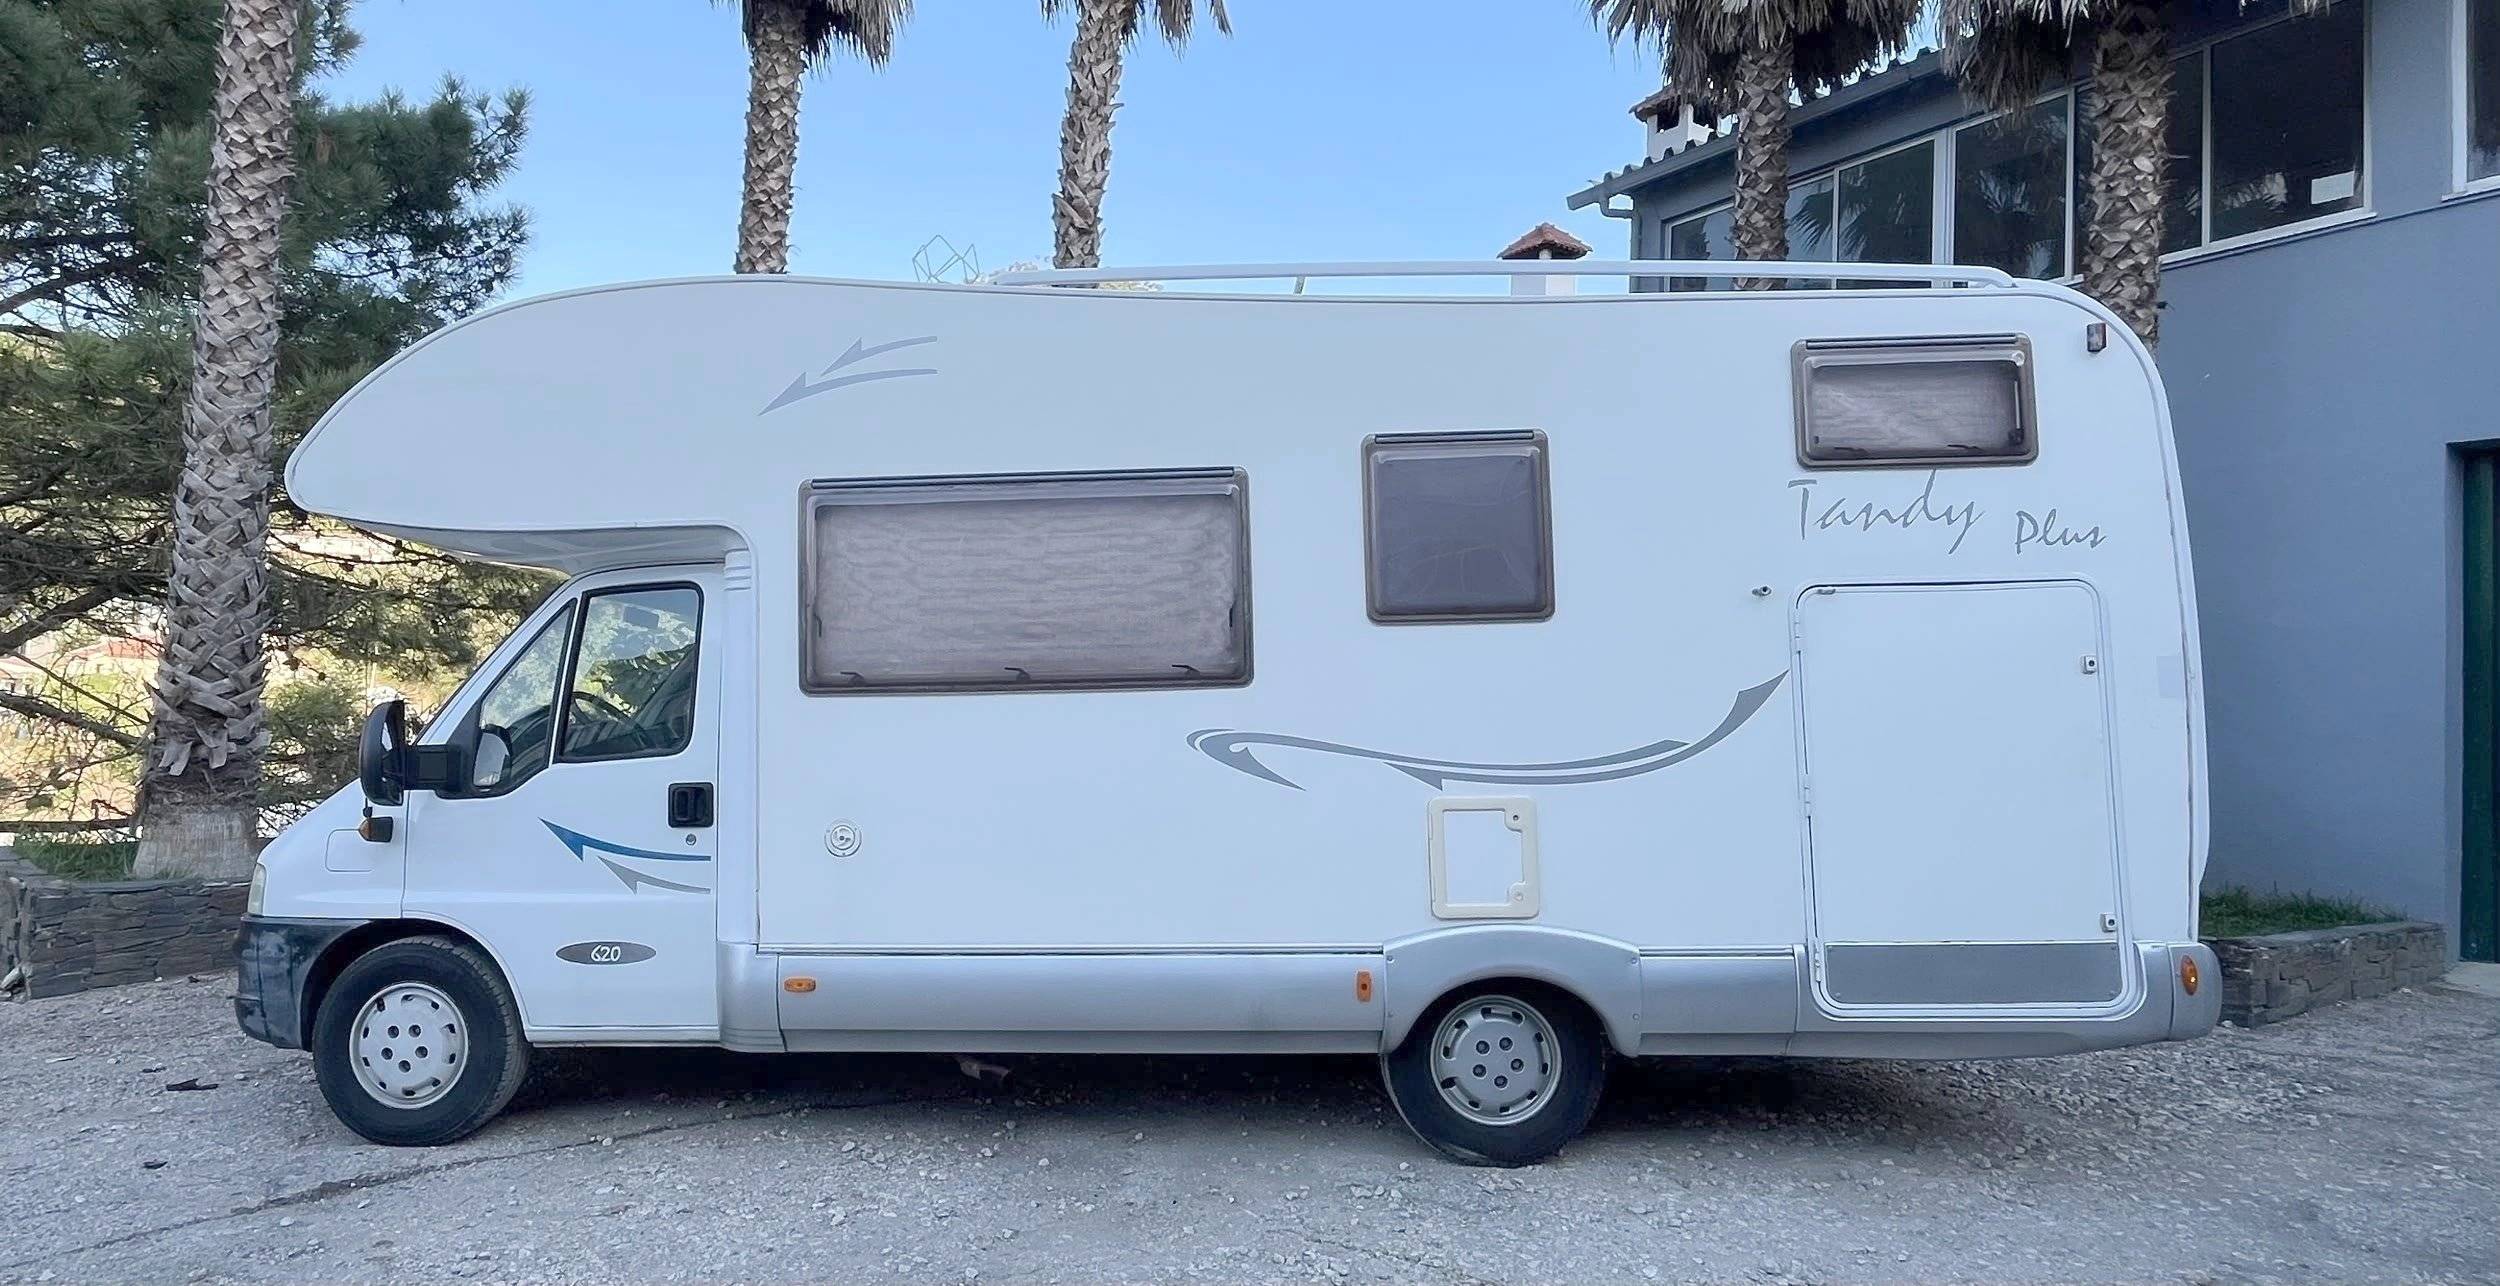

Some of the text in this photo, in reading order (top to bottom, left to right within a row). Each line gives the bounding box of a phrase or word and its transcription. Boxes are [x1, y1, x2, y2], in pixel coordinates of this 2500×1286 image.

[1788, 469, 2107, 555] Tandy Plus
[590, 945, 621, 962] 620
